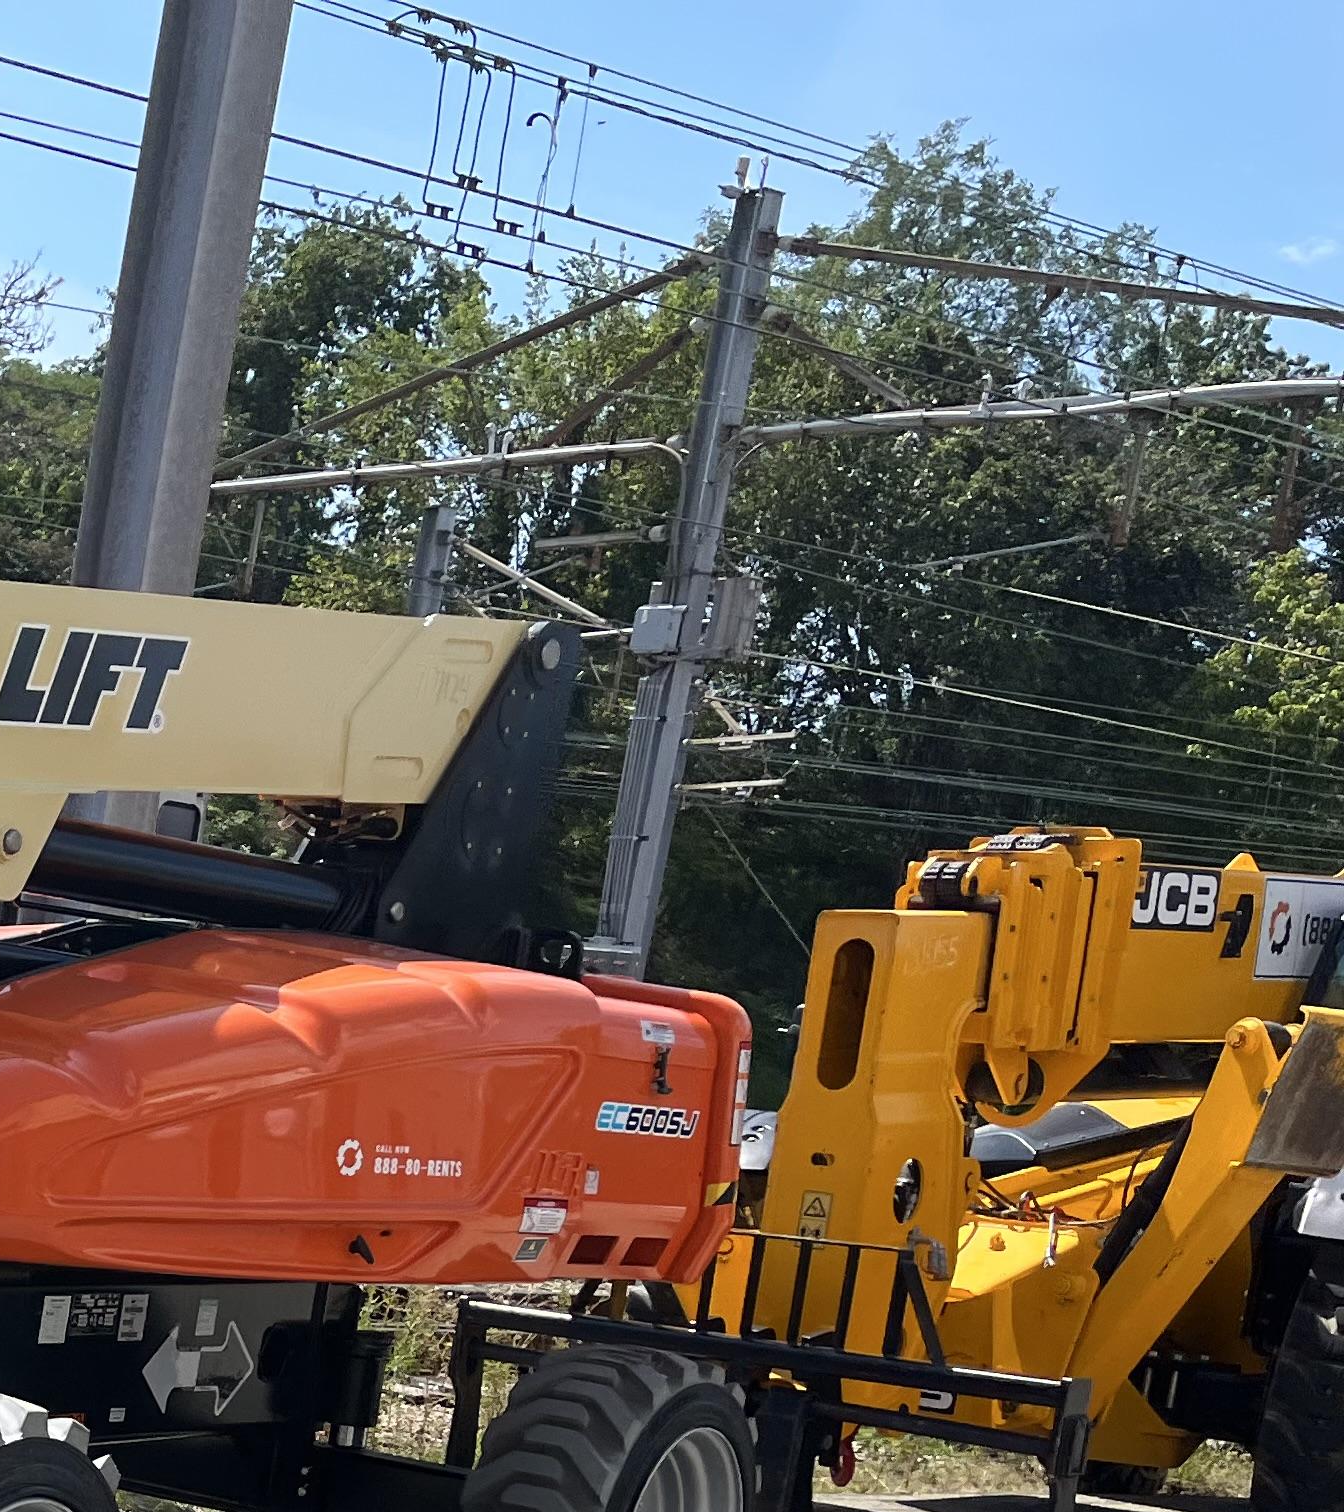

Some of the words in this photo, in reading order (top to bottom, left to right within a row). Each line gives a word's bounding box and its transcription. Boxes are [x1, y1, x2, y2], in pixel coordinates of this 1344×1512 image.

[1132, 871, 1218, 926] JCB
[595, 1101, 700, 1139] EC600SJ
[375, 1144, 393, 1154] CALL
[373, 1157, 462, 1177] 888-80-RENTS
